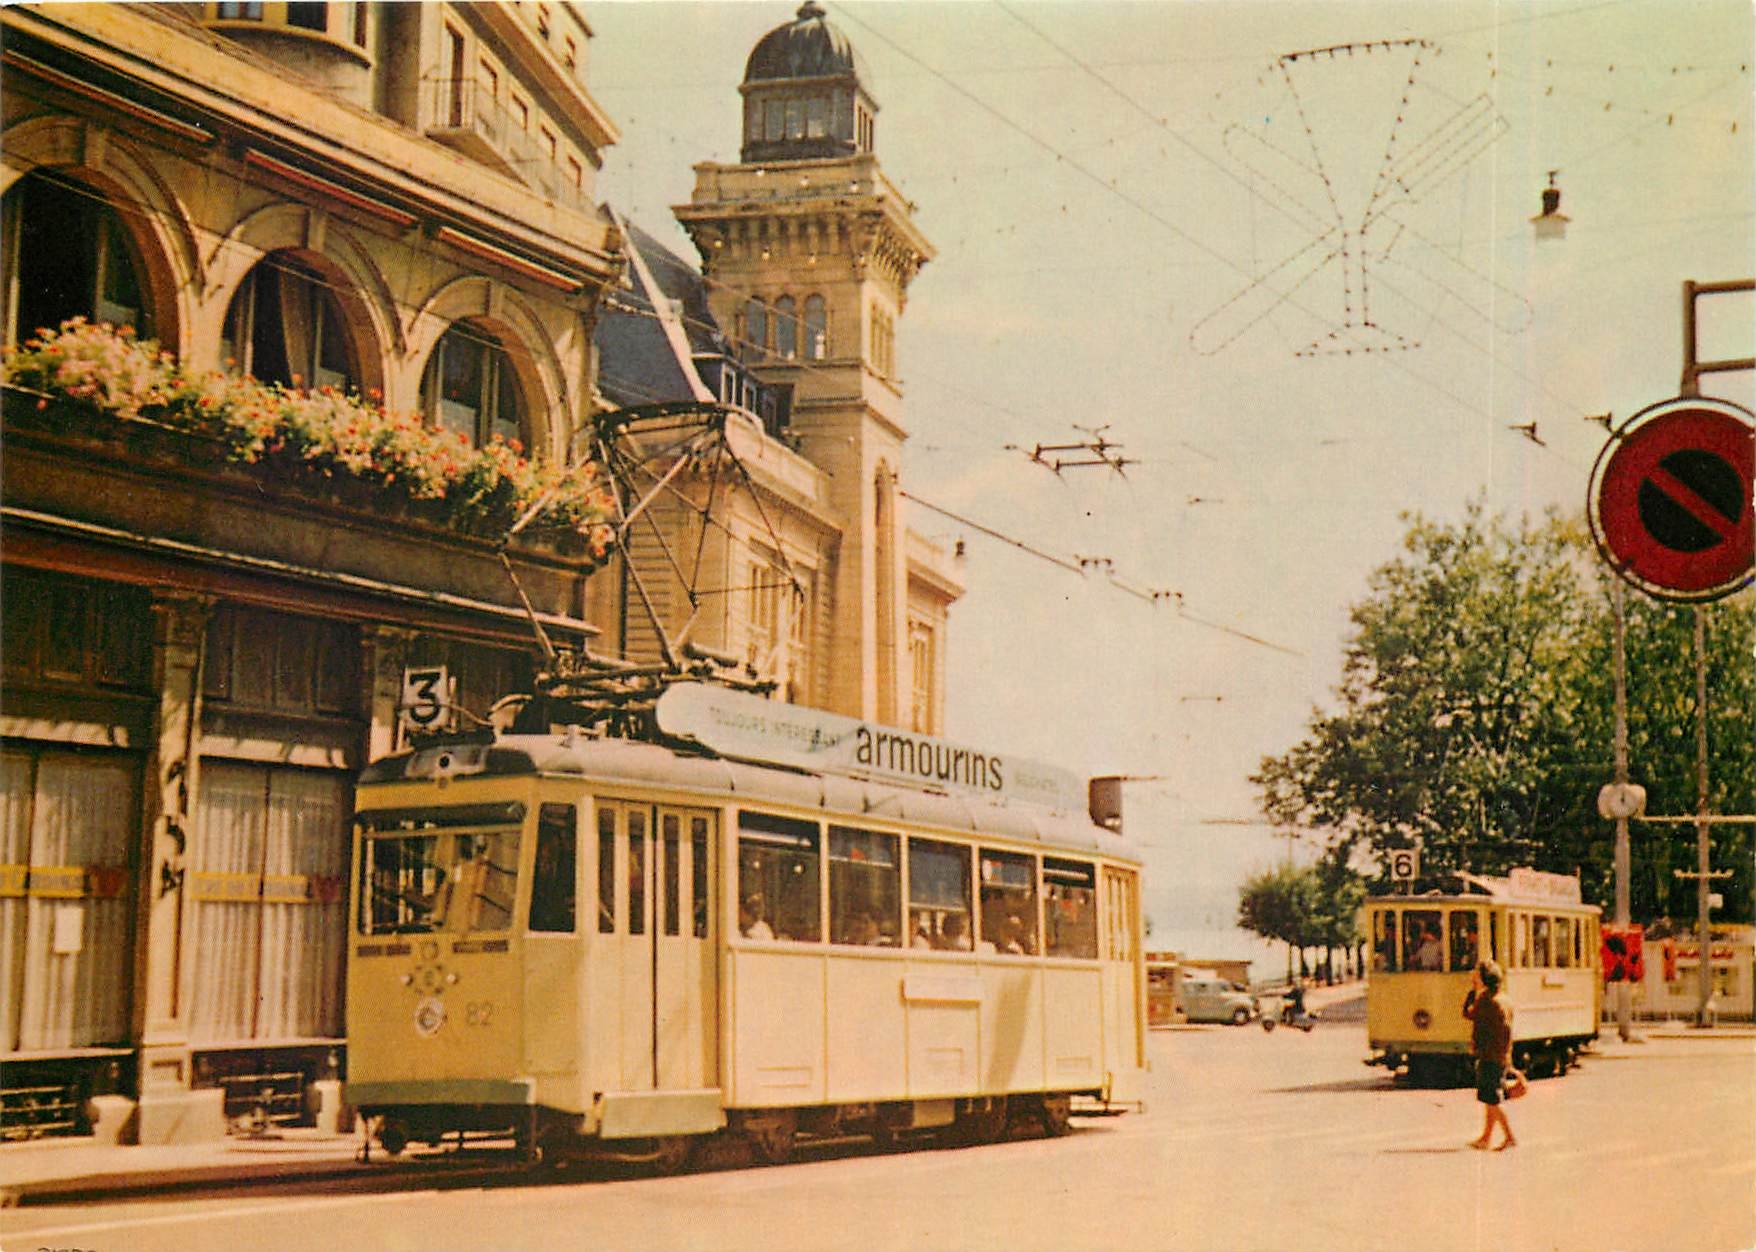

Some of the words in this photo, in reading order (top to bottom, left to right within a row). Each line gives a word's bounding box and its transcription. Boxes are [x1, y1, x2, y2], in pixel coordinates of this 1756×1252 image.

[409, 671, 441, 724] 3
[857, 726, 1003, 792] armourins
[1395, 853, 1412, 877] 6
[466, 1001, 493, 1026] 82
